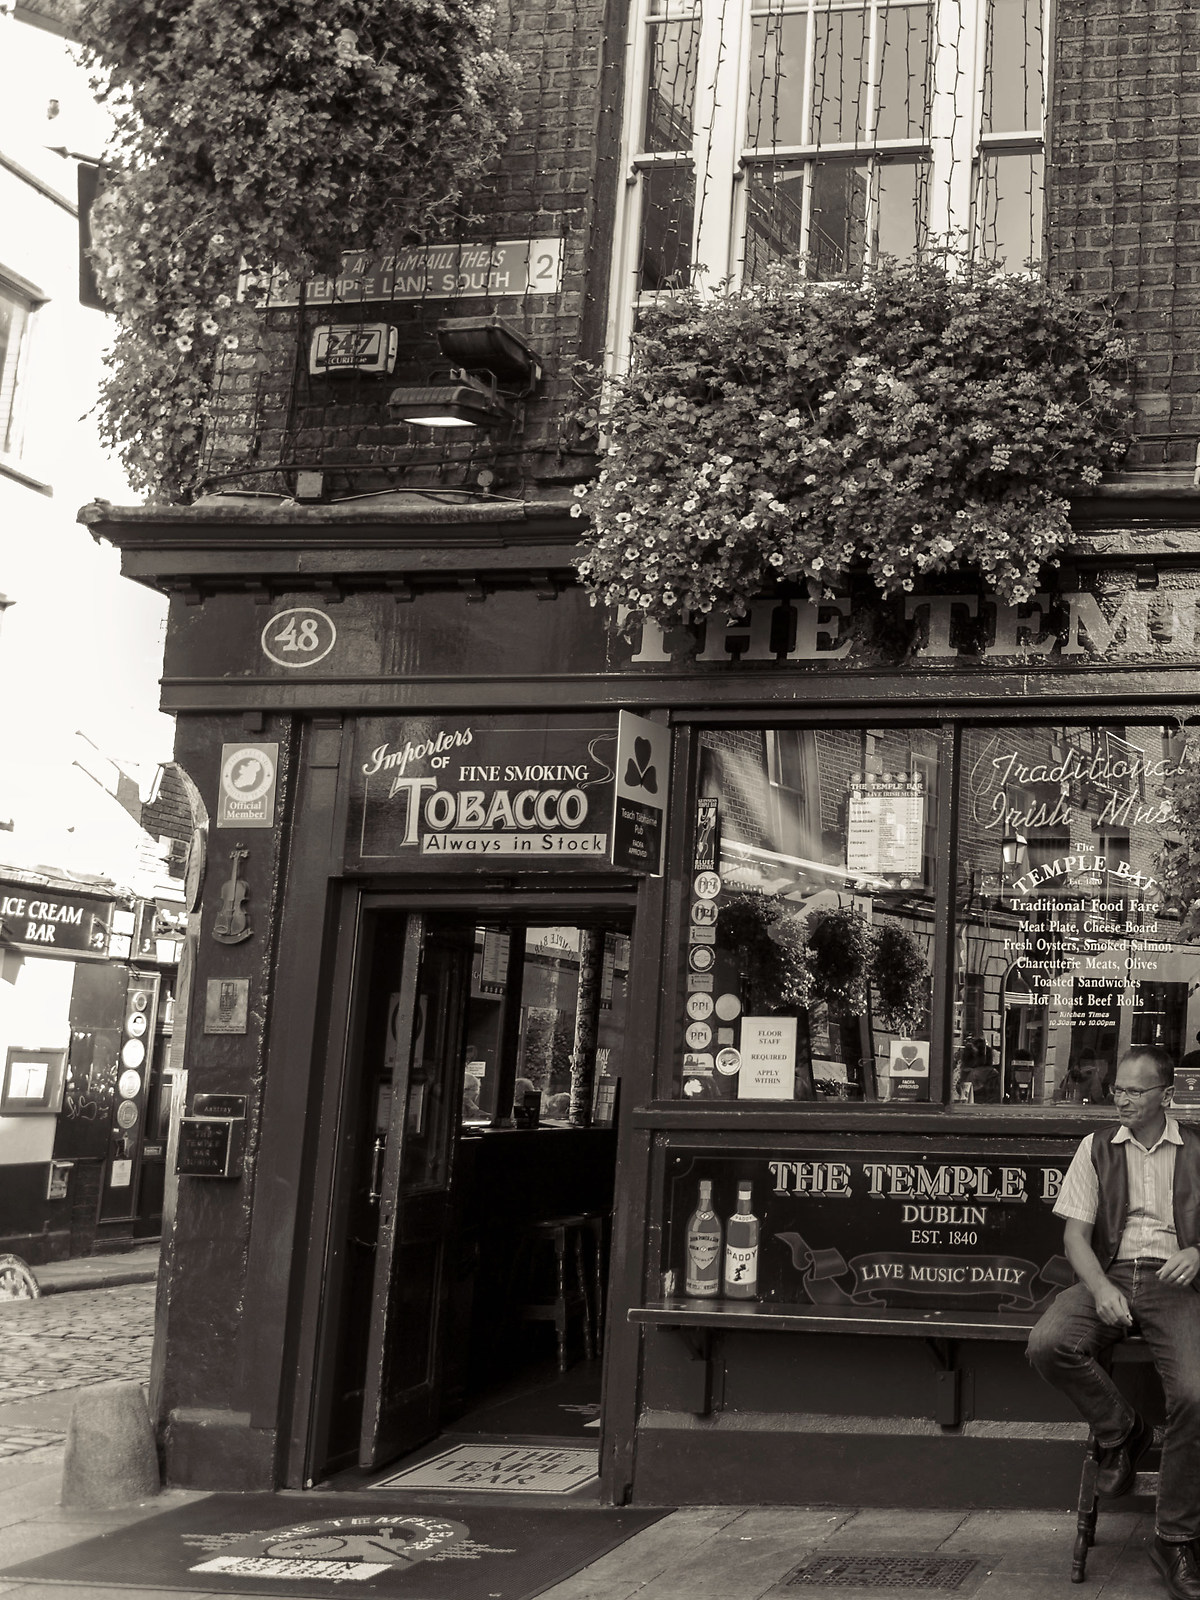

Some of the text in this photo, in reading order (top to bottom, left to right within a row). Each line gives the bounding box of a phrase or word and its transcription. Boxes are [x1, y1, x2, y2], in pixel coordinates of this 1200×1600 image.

[459, 249, 506, 268] THEAS
[536, 253, 554, 280] 2
[383, 275, 429, 293] LANE
[441, 271, 510, 291] SOUTH
[274, 617, 319, 652] 48
[616, 597, 855, 662] THE
[361, 727, 474, 776] Importers
[430, 756, 451, 770] OF
[458, 765, 590, 783] FINE SMOKING
[226, 810, 264, 818] Member
[229, 801, 262, 810] Official
[389, 776, 589, 847] TOBACCO
[984, 789, 1182, 829] Irish Mus
[426, 834, 602, 852] Always in Stock
[1075, 842, 1095, 853] The
[1012, 855, 1107, 896] TEMPLE
[1, 897, 84, 925] ICE CREAM
[1010, 898, 1159, 912] Traditional Food Fare
[25, 922, 56, 943] BAR
[1018, 921, 1158, 935] Meat Plate, Cheese Board
[1004, 939, 1172, 954] Fresh Oysters, Smoked Salmon
[1017, 957, 1158, 971] Charcuterie Meats, Olives
[1032, 975, 1142, 988] Toasted Sandwiches
[692, 1001, 709, 1011] PPI
[1029, 993, 1145, 1007] Hot Roast Beef Rolls
[691, 1031, 707, 1041] PPI
[768, 1161, 854, 1199] THE
[863, 1163, 1029, 1203] TEMPLE
[902, 1203, 987, 1226] DUBLIN
[910, 1229, 979, 1246] EST. 1840
[726, 1248, 757, 1262] PADDY
[860, 1264, 1027, 1287] LIVE MUSIC DAILY
[500, 1450, 580, 1463] THE
[435, 1460, 597, 1475] TEMPLE
[448, 1472, 536, 1485] BAR
[262, 1525, 320, 1542] THE
